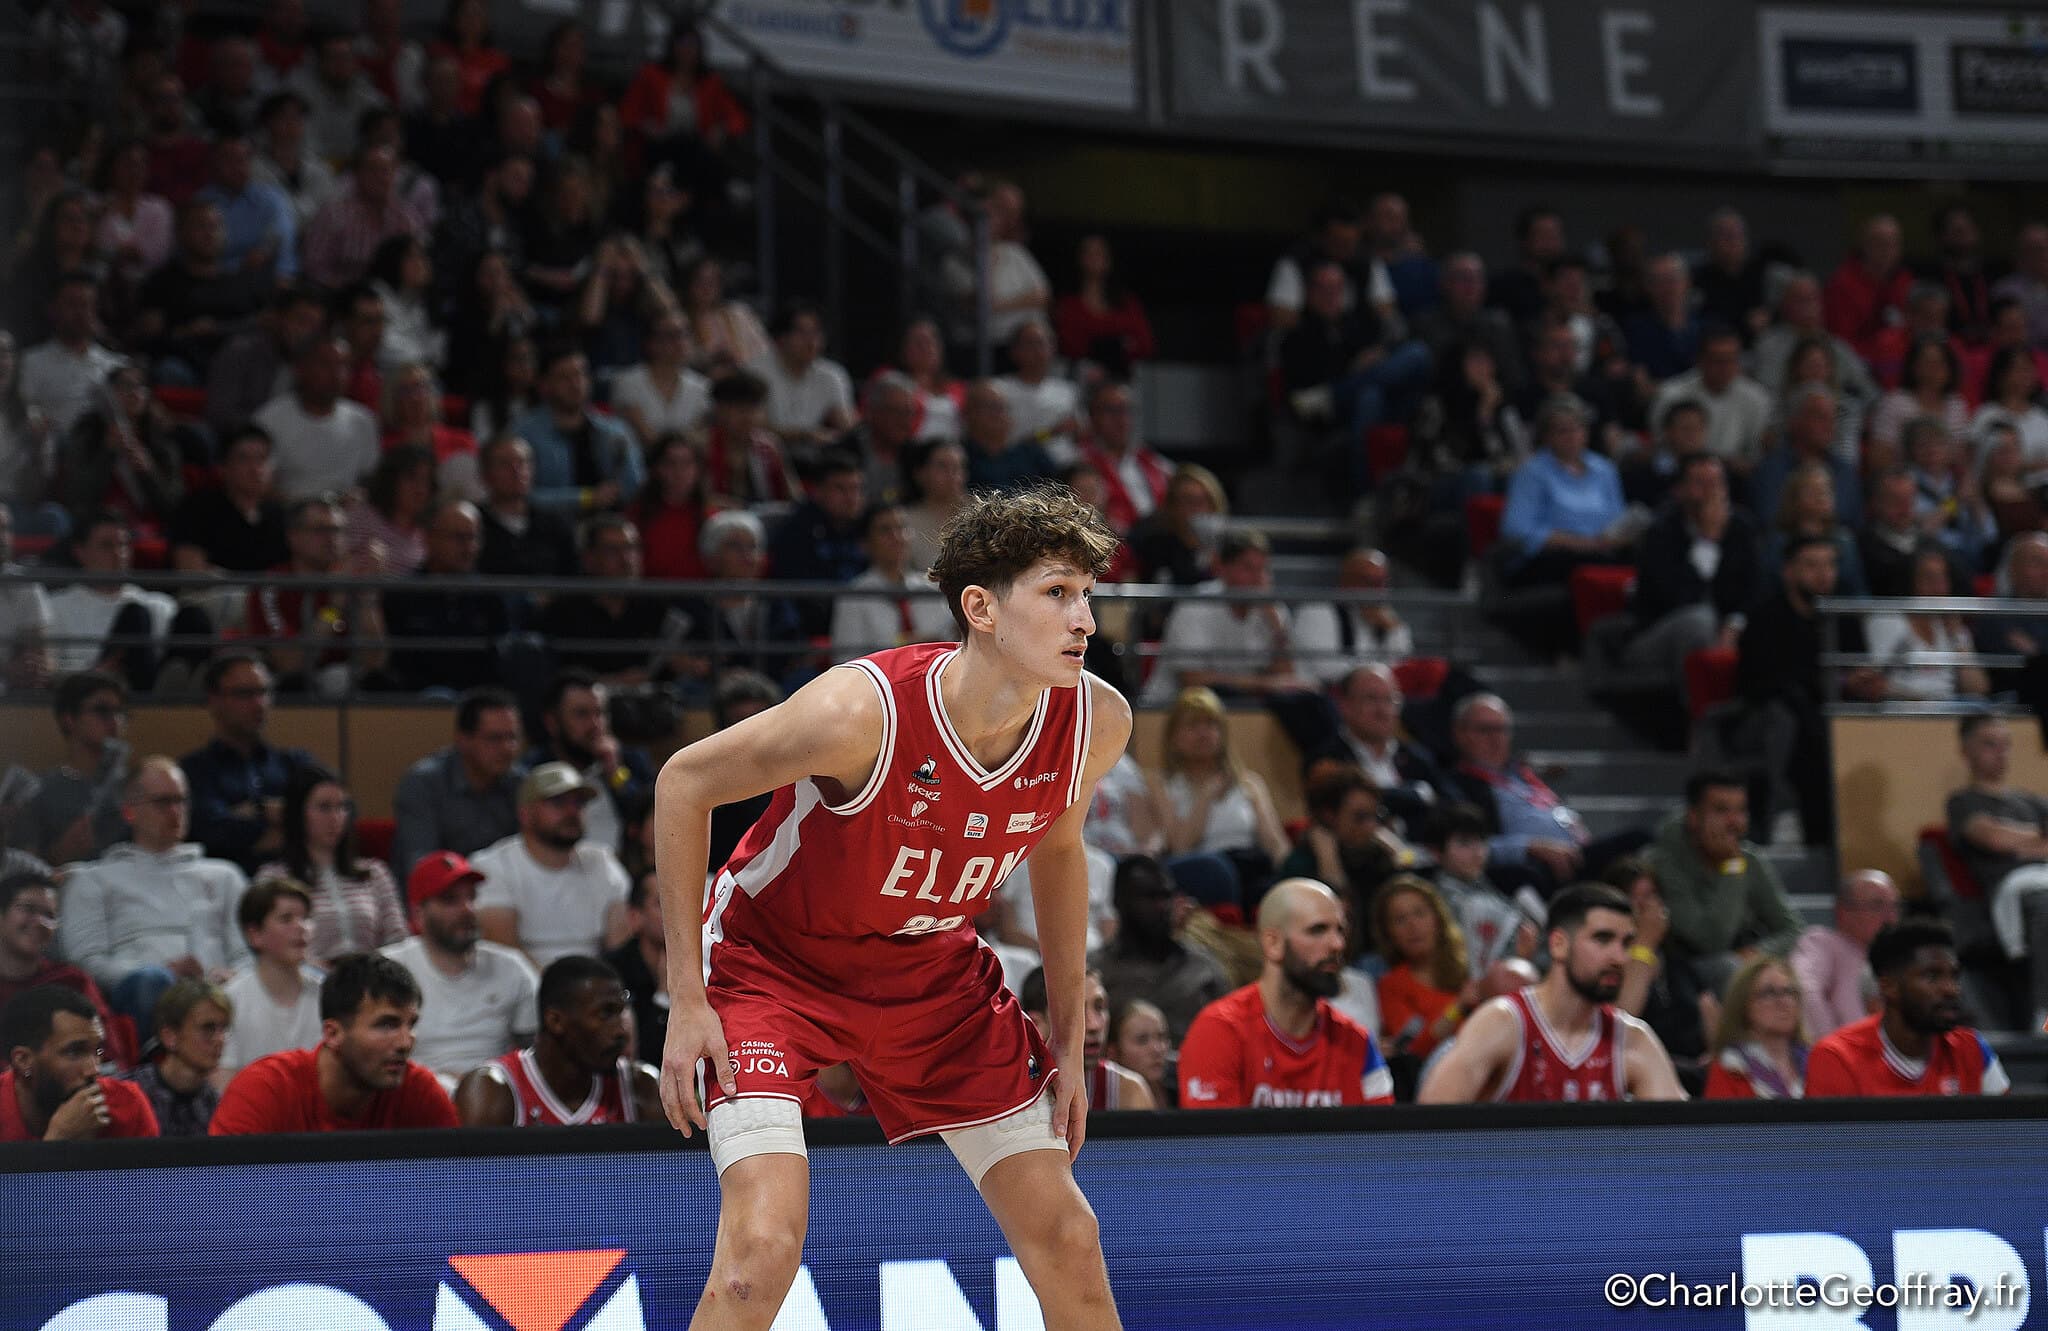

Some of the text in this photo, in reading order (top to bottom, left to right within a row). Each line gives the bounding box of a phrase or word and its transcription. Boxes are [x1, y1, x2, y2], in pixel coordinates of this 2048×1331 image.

[907, 782, 942, 801] KICKZ
[880, 845, 1028, 904] ELAN
[741, 1048, 785, 1058] SANTENAY
[744, 1057, 789, 1078] JOA
